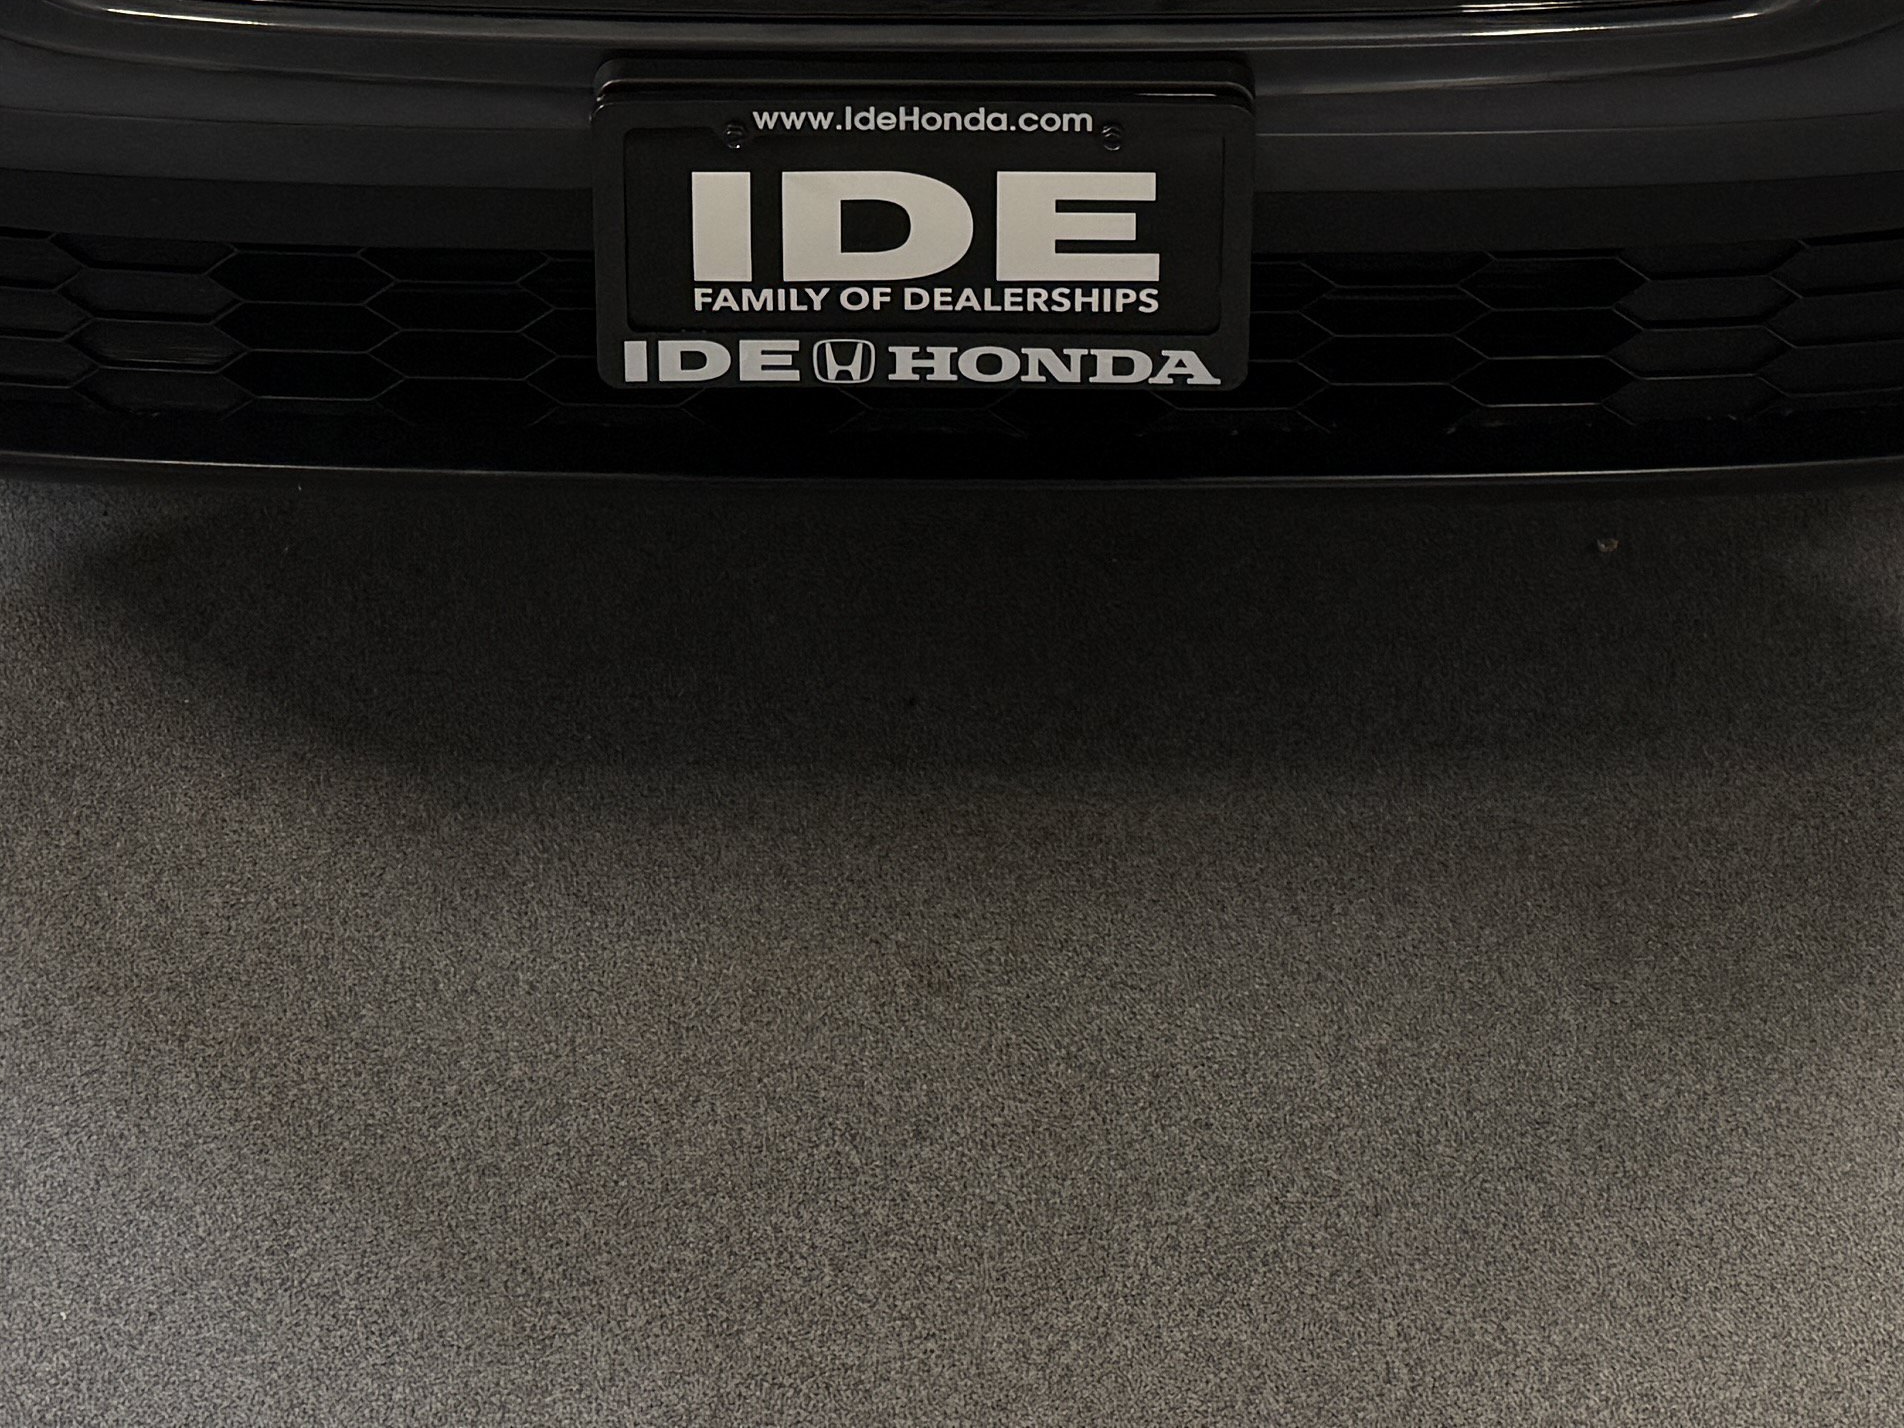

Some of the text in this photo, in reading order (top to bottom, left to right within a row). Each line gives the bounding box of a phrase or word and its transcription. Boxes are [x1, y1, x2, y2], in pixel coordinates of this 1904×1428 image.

[752, 105, 1093, 133] www.IdeHonda.com
[691, 170, 1160, 283] IDE
[693, 286, 1160, 313] FAMILY OF DEALERSHIPS
[623, 339, 801, 383] IDE
[887, 345, 1222, 385] HONDA
